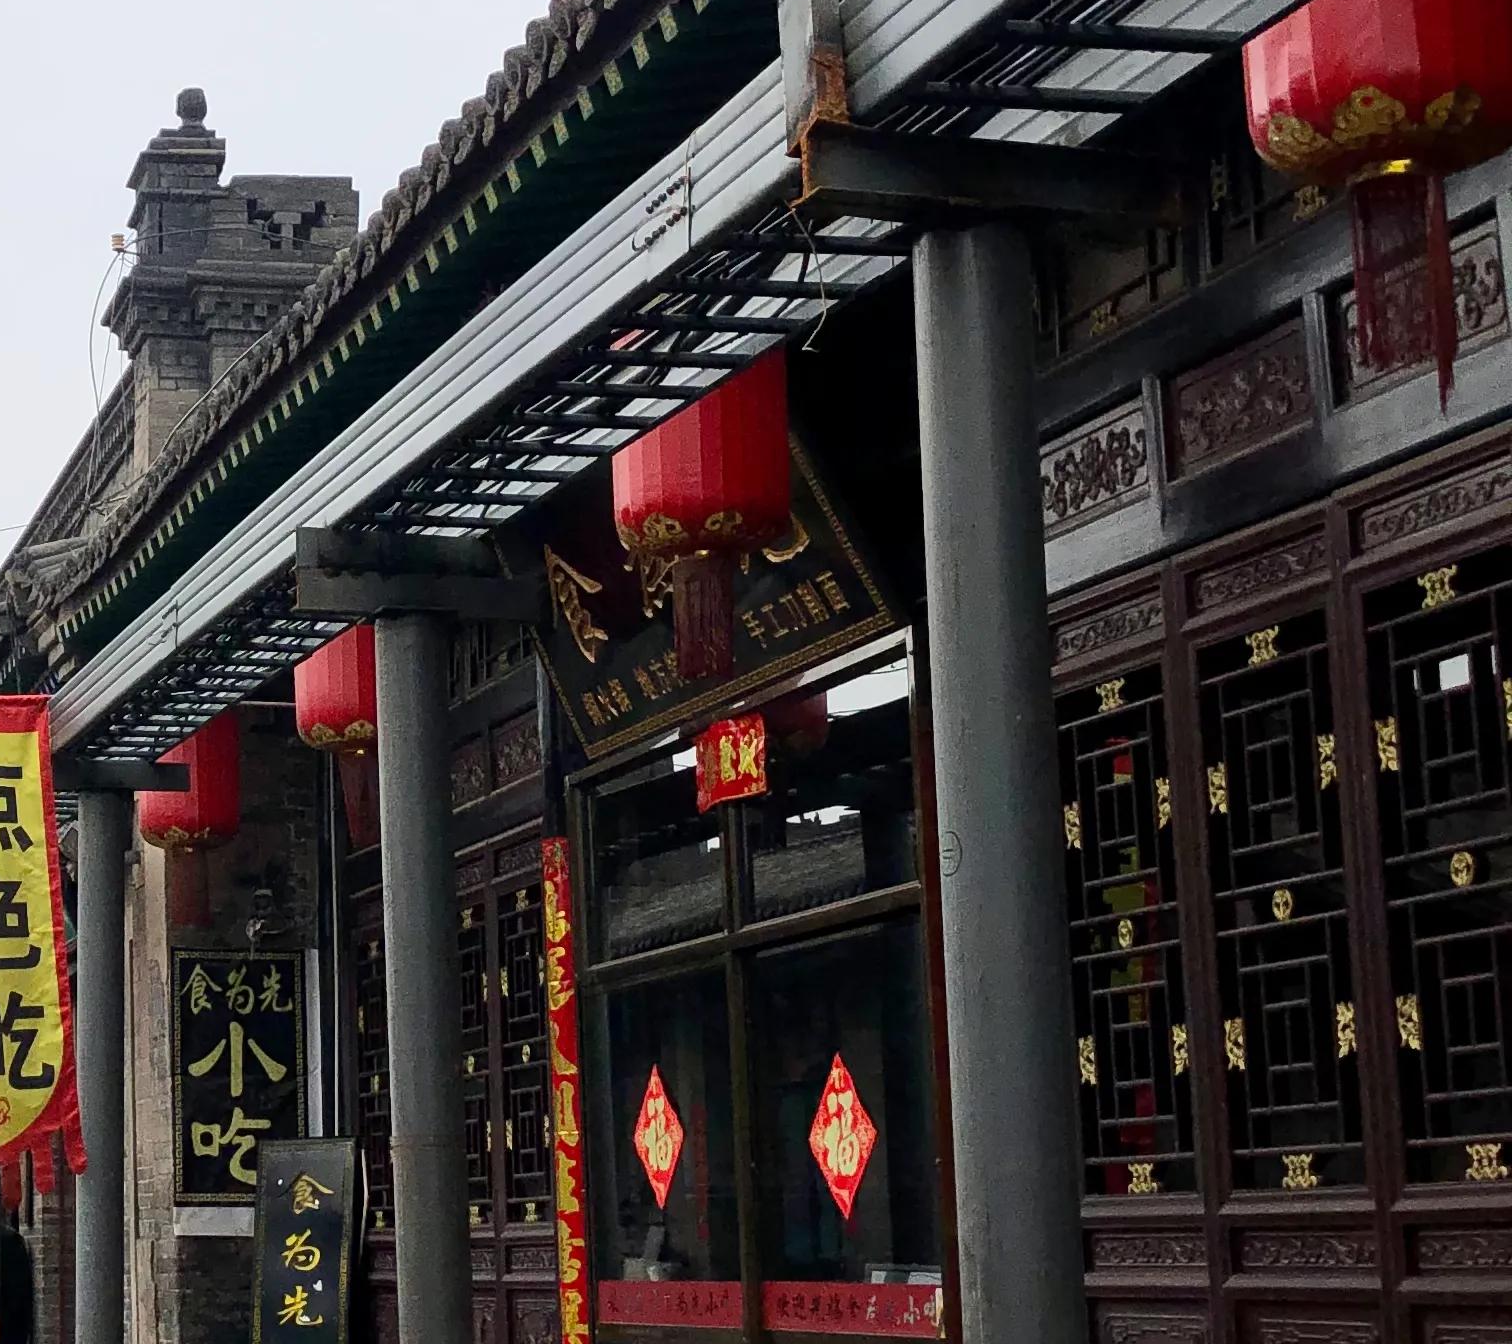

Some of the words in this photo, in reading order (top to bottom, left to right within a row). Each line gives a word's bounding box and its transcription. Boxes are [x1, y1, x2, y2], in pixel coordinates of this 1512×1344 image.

[179, 962, 294, 1015] 食为先
[188, 1021, 287, 1185] 小吃
[644, 1095, 672, 1171] 福
[823, 1090, 861, 1176] 福
